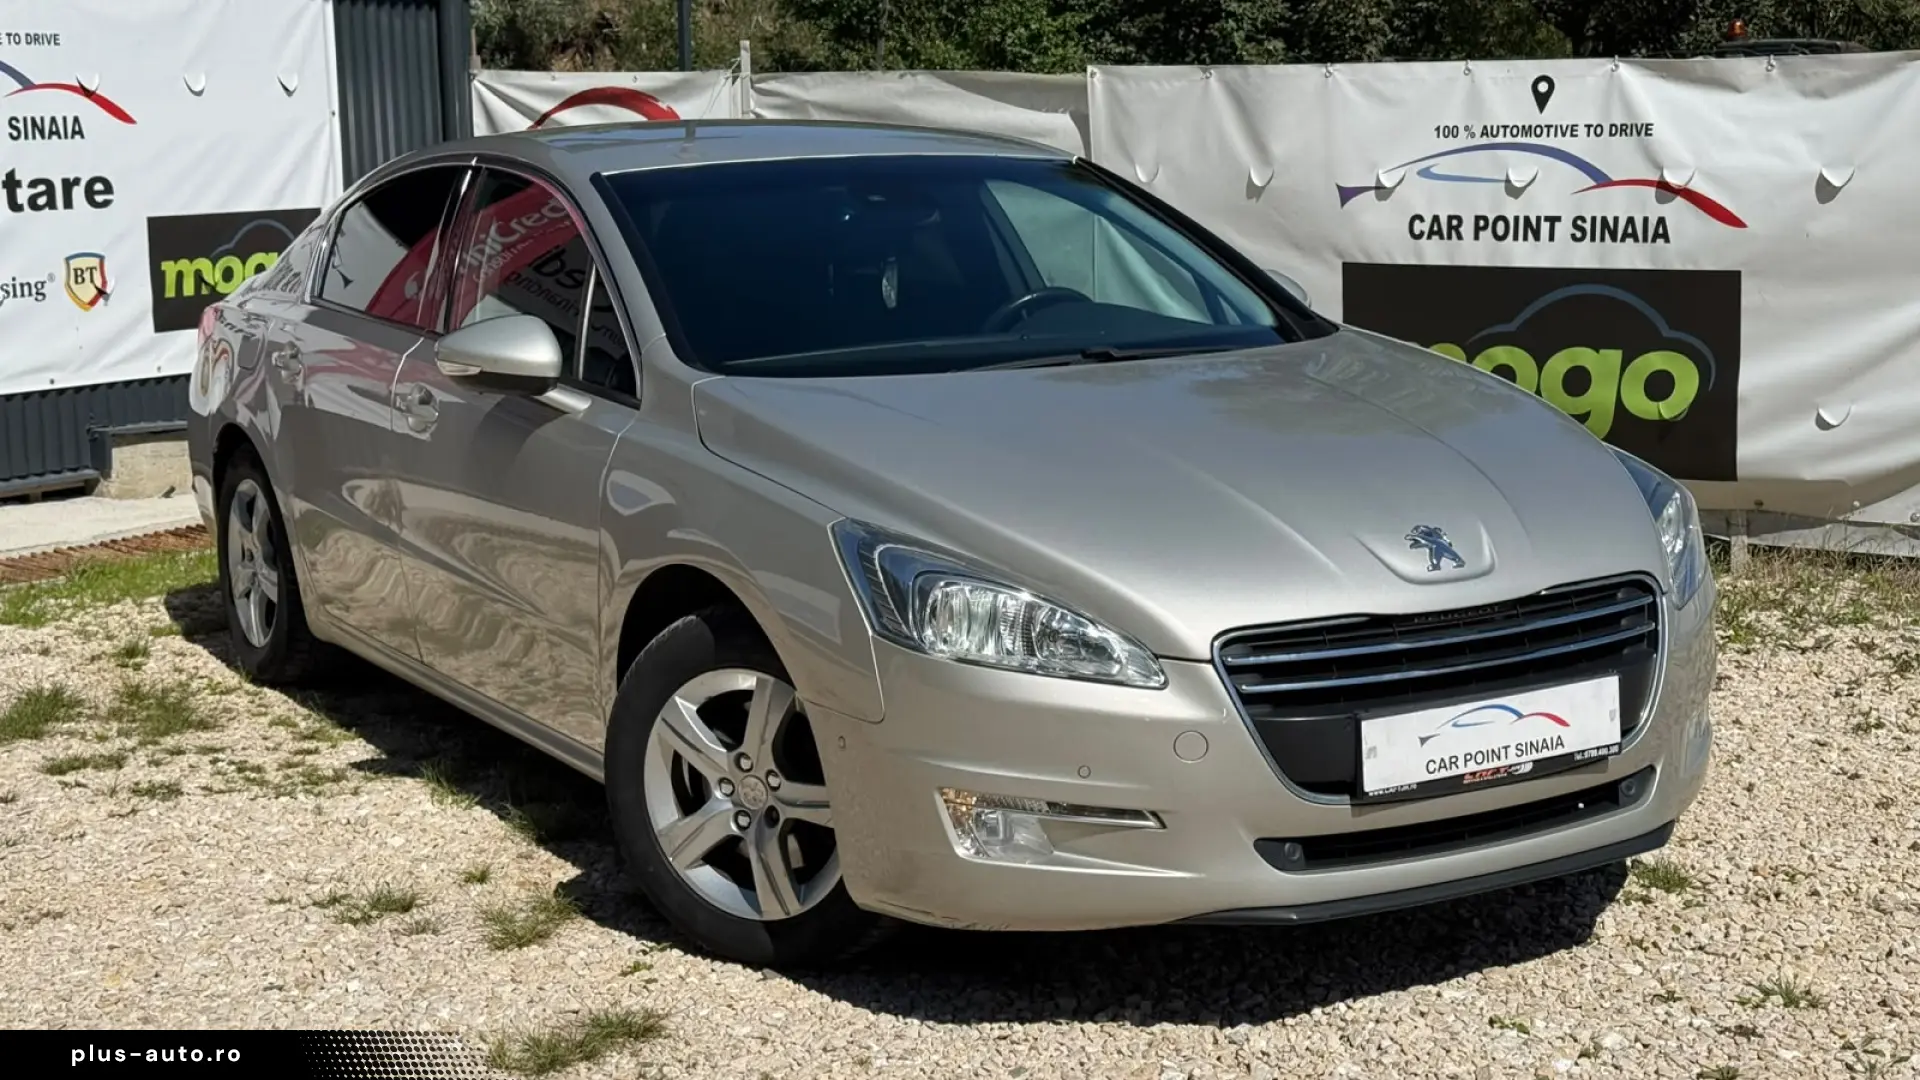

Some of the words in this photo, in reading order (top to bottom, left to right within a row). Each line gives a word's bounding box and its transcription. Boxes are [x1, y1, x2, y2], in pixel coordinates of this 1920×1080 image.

[5, 32, 22, 46] TO
[25, 32, 61, 47] DRIVE
[8, 115, 85, 141] SINAIA
[1433, 125, 1459, 139] 100
[1463, 124, 1476, 139] %
[1480, 124, 1579, 139] AUTOMOTIVE
[1585, 123, 1604, 138] TO
[1608, 123, 1654, 138] DRIVE
[1, 167, 115, 213] tare
[1408, 214, 1464, 242] CAR
[1473, 214, 1562, 242] POINT
[1570, 215, 1671, 244] SINAIA
[72, 266, 98, 285] BT
[1428, 342, 1700, 440] ogo
[1426, 755, 1459, 775] CAR
[1463, 744, 1511, 768] POINT
[1515, 734, 1565, 757] SINAIA
